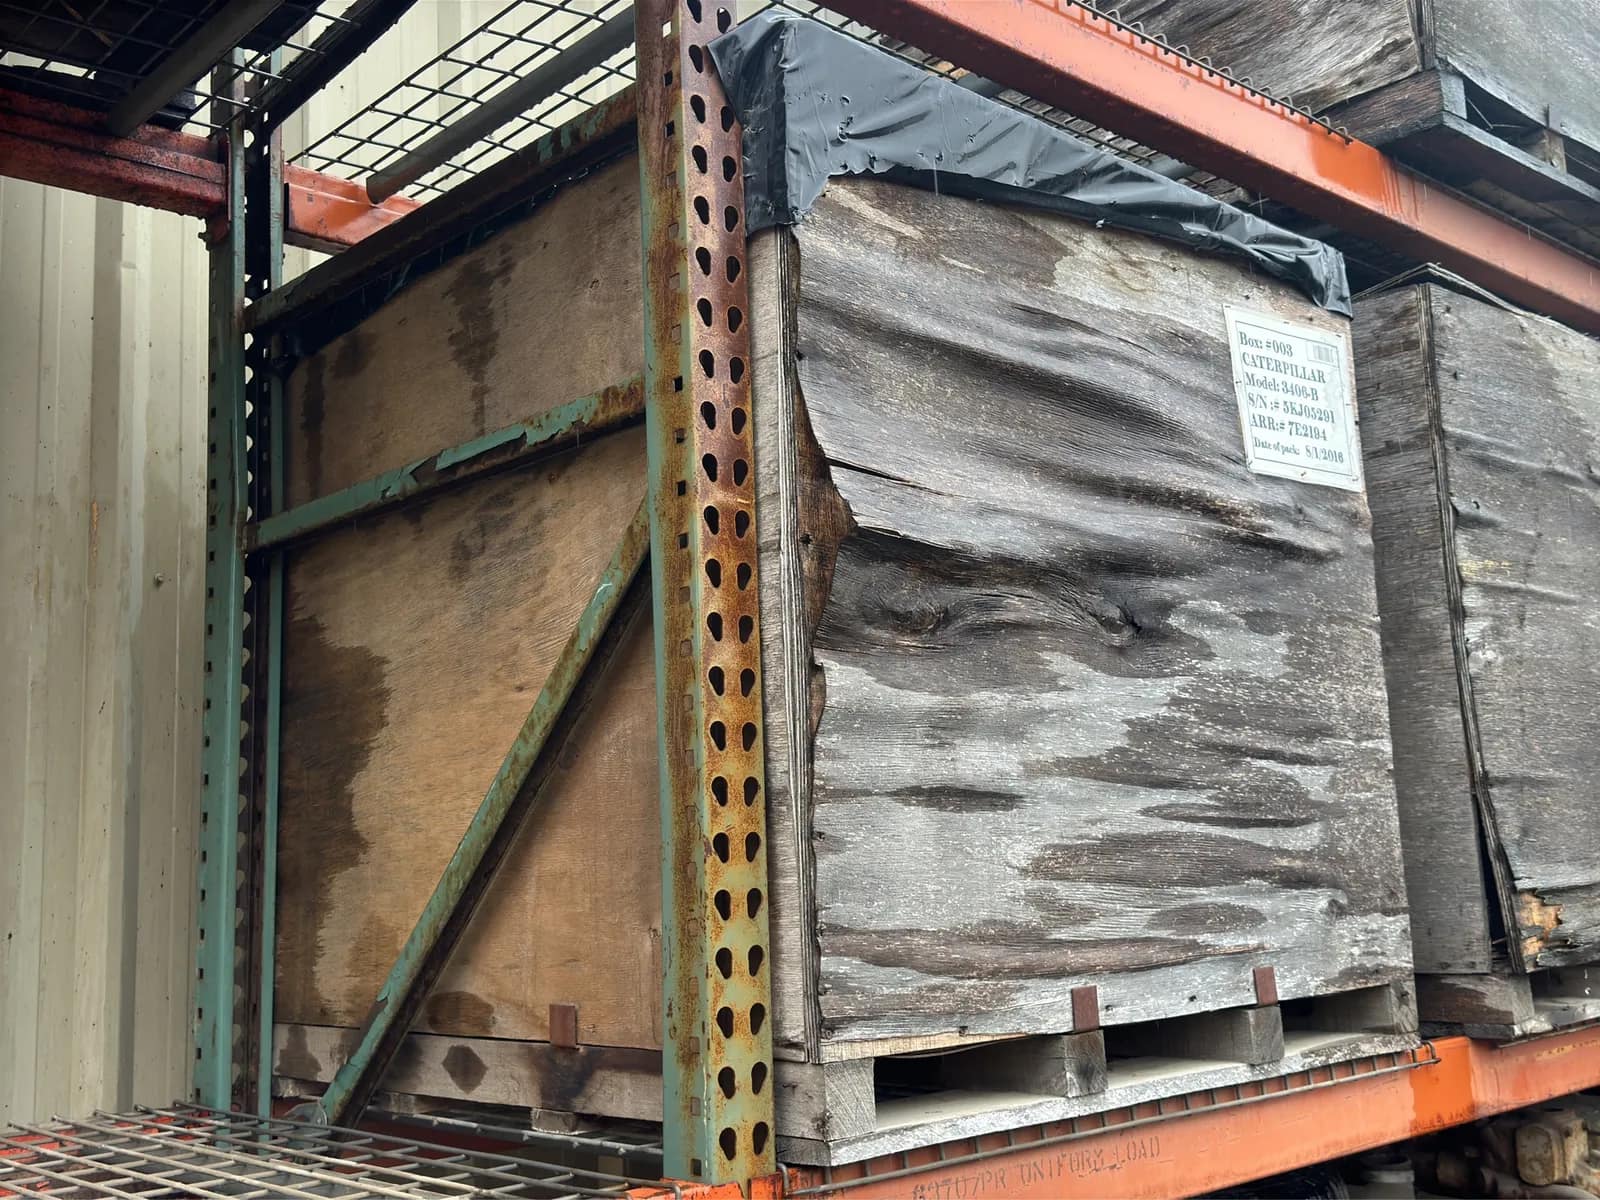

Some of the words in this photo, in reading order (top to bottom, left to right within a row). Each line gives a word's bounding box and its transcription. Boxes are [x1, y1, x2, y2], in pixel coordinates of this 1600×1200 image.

[1239, 331, 1263, 349] Box:
[1242, 351, 1326, 384] CATERPILLAR
[1244, 371, 1280, 393] Model:
[1281, 380, 1319, 401] 3406-B
[1248, 393, 1268, 410] S/N
[1283, 401, 1335, 424] 5KJ05291
[1288, 421, 1328, 442] 7E2194
[1254, 436, 1272, 451] Date
[1280, 441, 1300, 456] pack:
[1305, 445, 1344, 464] 8/1/2016
